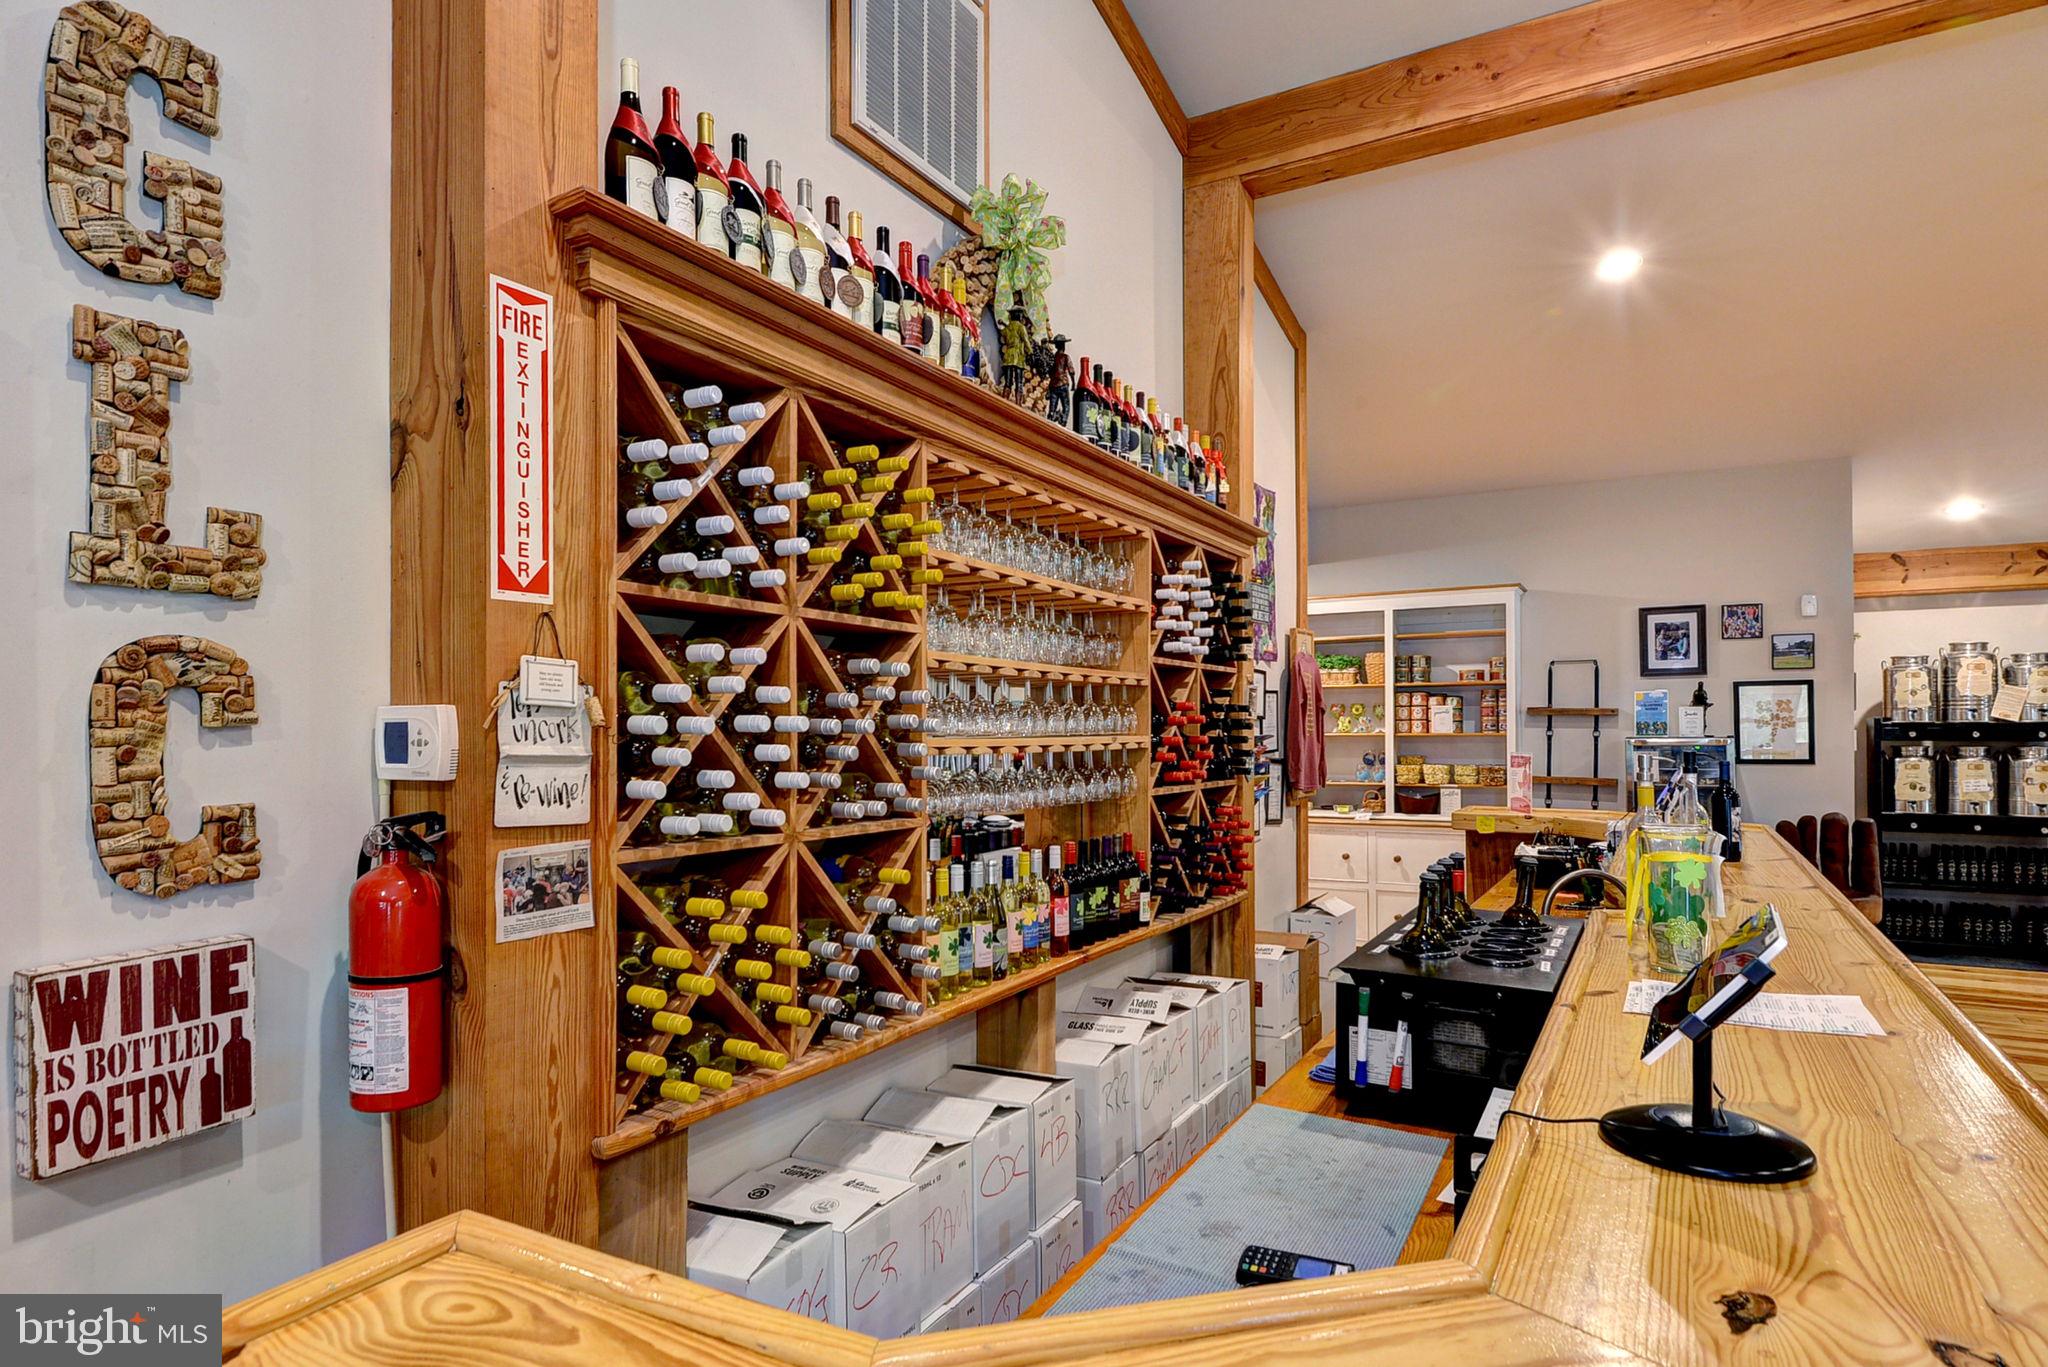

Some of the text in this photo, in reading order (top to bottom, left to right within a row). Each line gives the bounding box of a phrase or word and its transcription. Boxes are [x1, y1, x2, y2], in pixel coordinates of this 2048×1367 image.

[503, 304, 543, 341] FIRE
[517, 341, 531, 579] EXTINGUISHER
[512, 715, 581, 745] uncork
[35, 944, 249, 1053] WINE
[1067, 1020, 1095, 1031] GLASS
[1129, 999, 1159, 1009] SUPPLY
[43, 1021, 220, 1096] IS BOTTLED
[47, 1065, 192, 1169] POETRY
